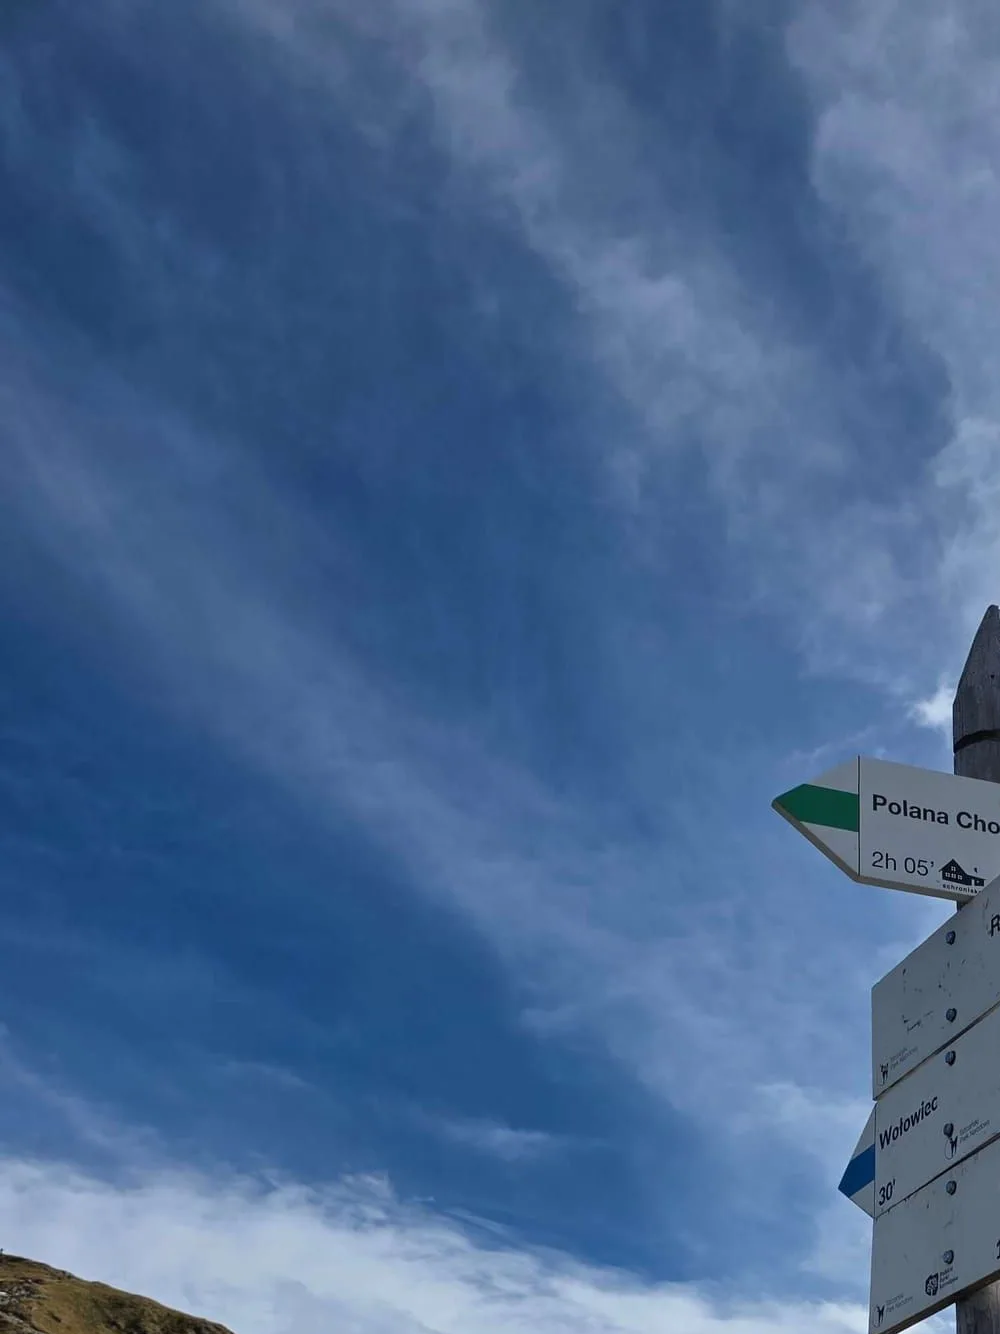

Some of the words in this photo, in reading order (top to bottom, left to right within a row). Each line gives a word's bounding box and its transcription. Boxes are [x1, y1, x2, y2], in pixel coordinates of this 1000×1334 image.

[872, 793, 949, 825] Polana
[871, 851, 897, 871] 2h
[904, 857, 935, 877] 05'
[879, 1096, 938, 1150] Wołowiec
[878, 1178, 896, 1206] 30'
